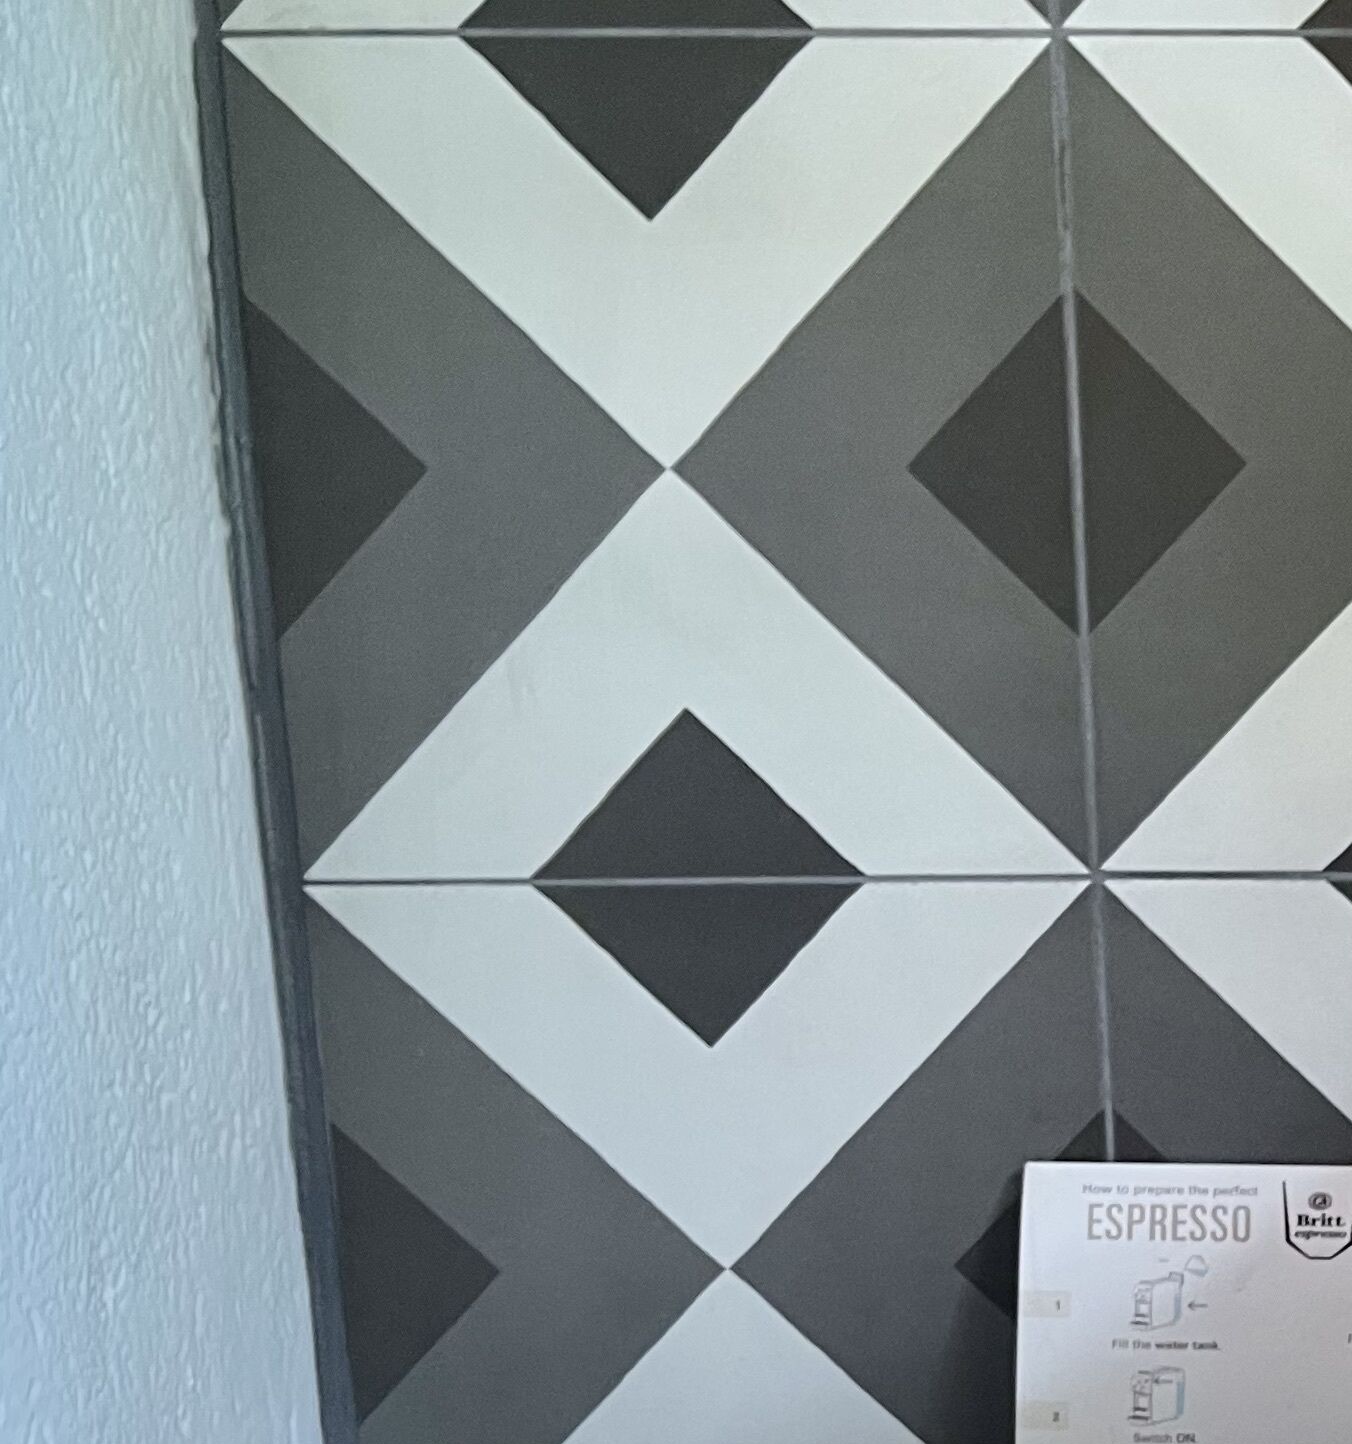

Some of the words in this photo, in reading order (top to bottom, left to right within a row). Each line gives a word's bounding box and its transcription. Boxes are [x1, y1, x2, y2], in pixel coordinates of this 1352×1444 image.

[1082, 1184, 1113, 1195] How
[1117, 1184, 1130, 1195] to
[1133, 1186, 1185, 1198] prepare
[1189, 1185, 1210, 1196] the
[1212, 1186, 1258, 1199] perfect
[1087, 1202, 1251, 1243] ESPRESSO
[1297, 1212, 1347, 1228] Britt
